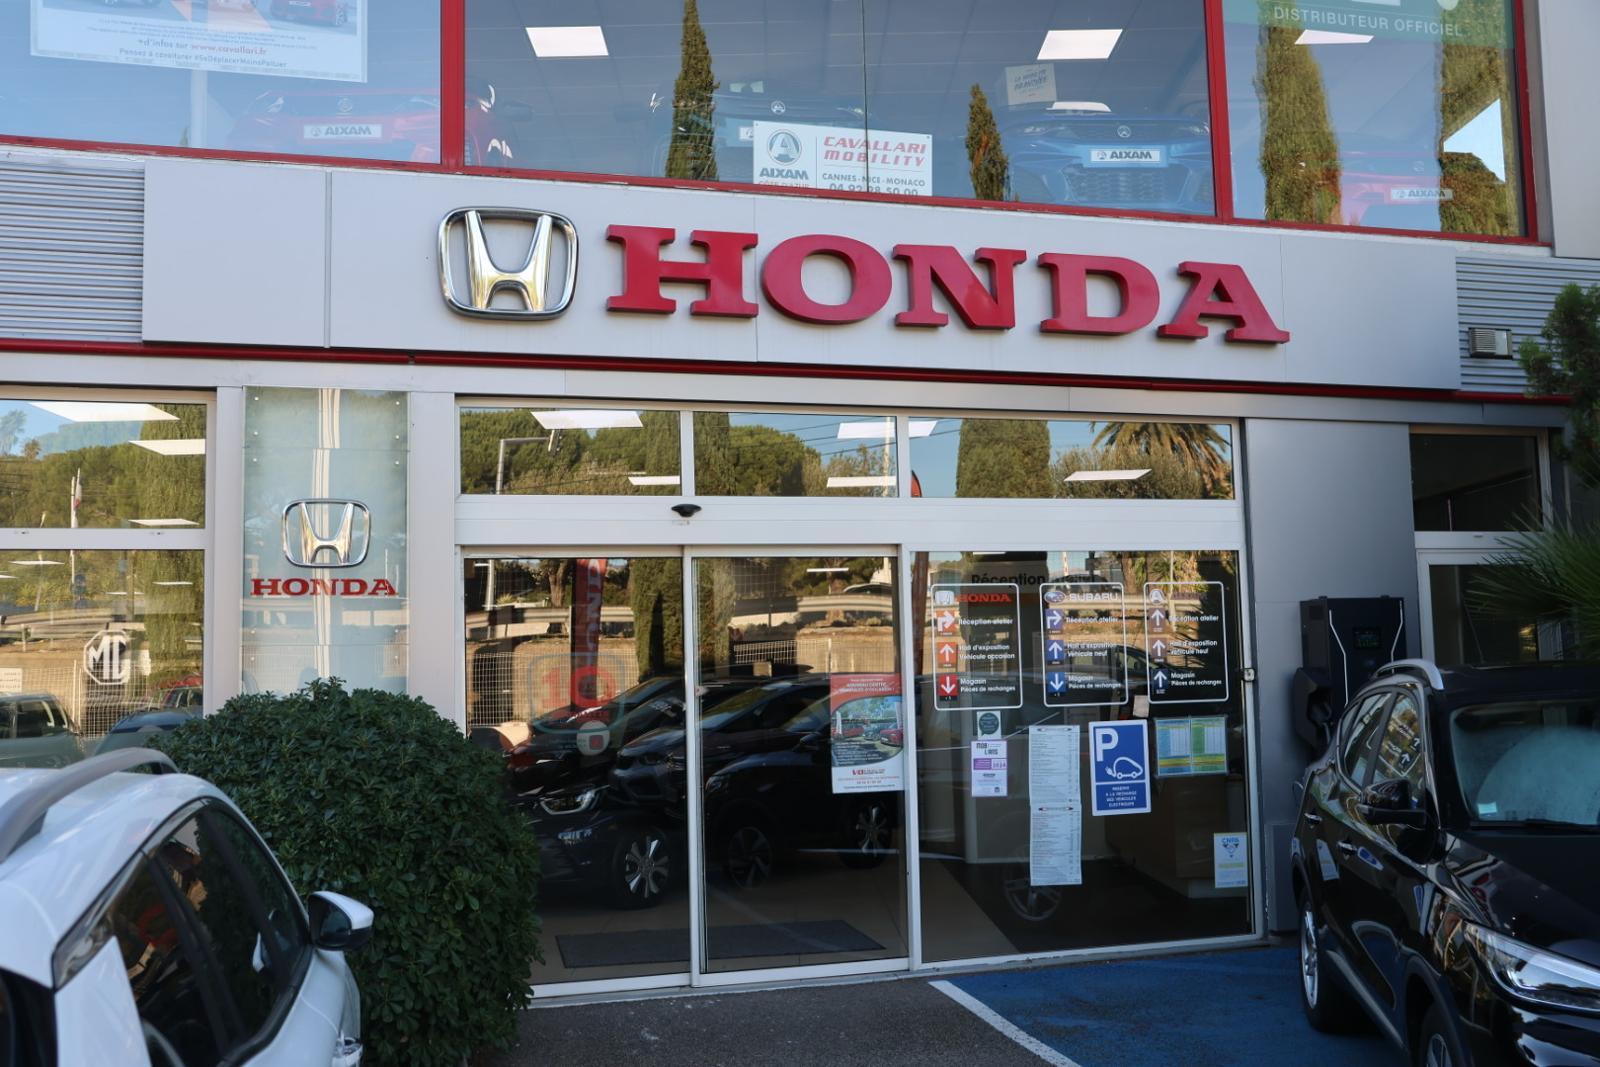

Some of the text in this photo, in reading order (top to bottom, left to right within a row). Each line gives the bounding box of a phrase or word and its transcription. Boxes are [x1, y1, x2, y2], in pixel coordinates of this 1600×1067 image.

[1273, 6, 1463, 38] DISTRIBUTEUR OFFICIEL
[324, 126, 373, 137] AIXAM
[823, 136, 926, 154] CAVALLARI
[823, 149, 926, 167] MOBILITY
[1109, 150, 1153, 160] AIXAM
[759, 166, 809, 180] AIXAM
[822, 173, 926, 187] CANNES NICE MONACO
[605, 223, 1291, 345] HONDA
[971, 570, 1046, 588] Réception
[249, 577, 399, 597] HONDA
[1069, 592, 1119, 601] SUBARU
[960, 677, 987, 688] Magasin
[1170, 671, 1195, 681] Magasin
[1196, 678, 1222, 688] rechanges
[1095, 727, 1119, 762] P
